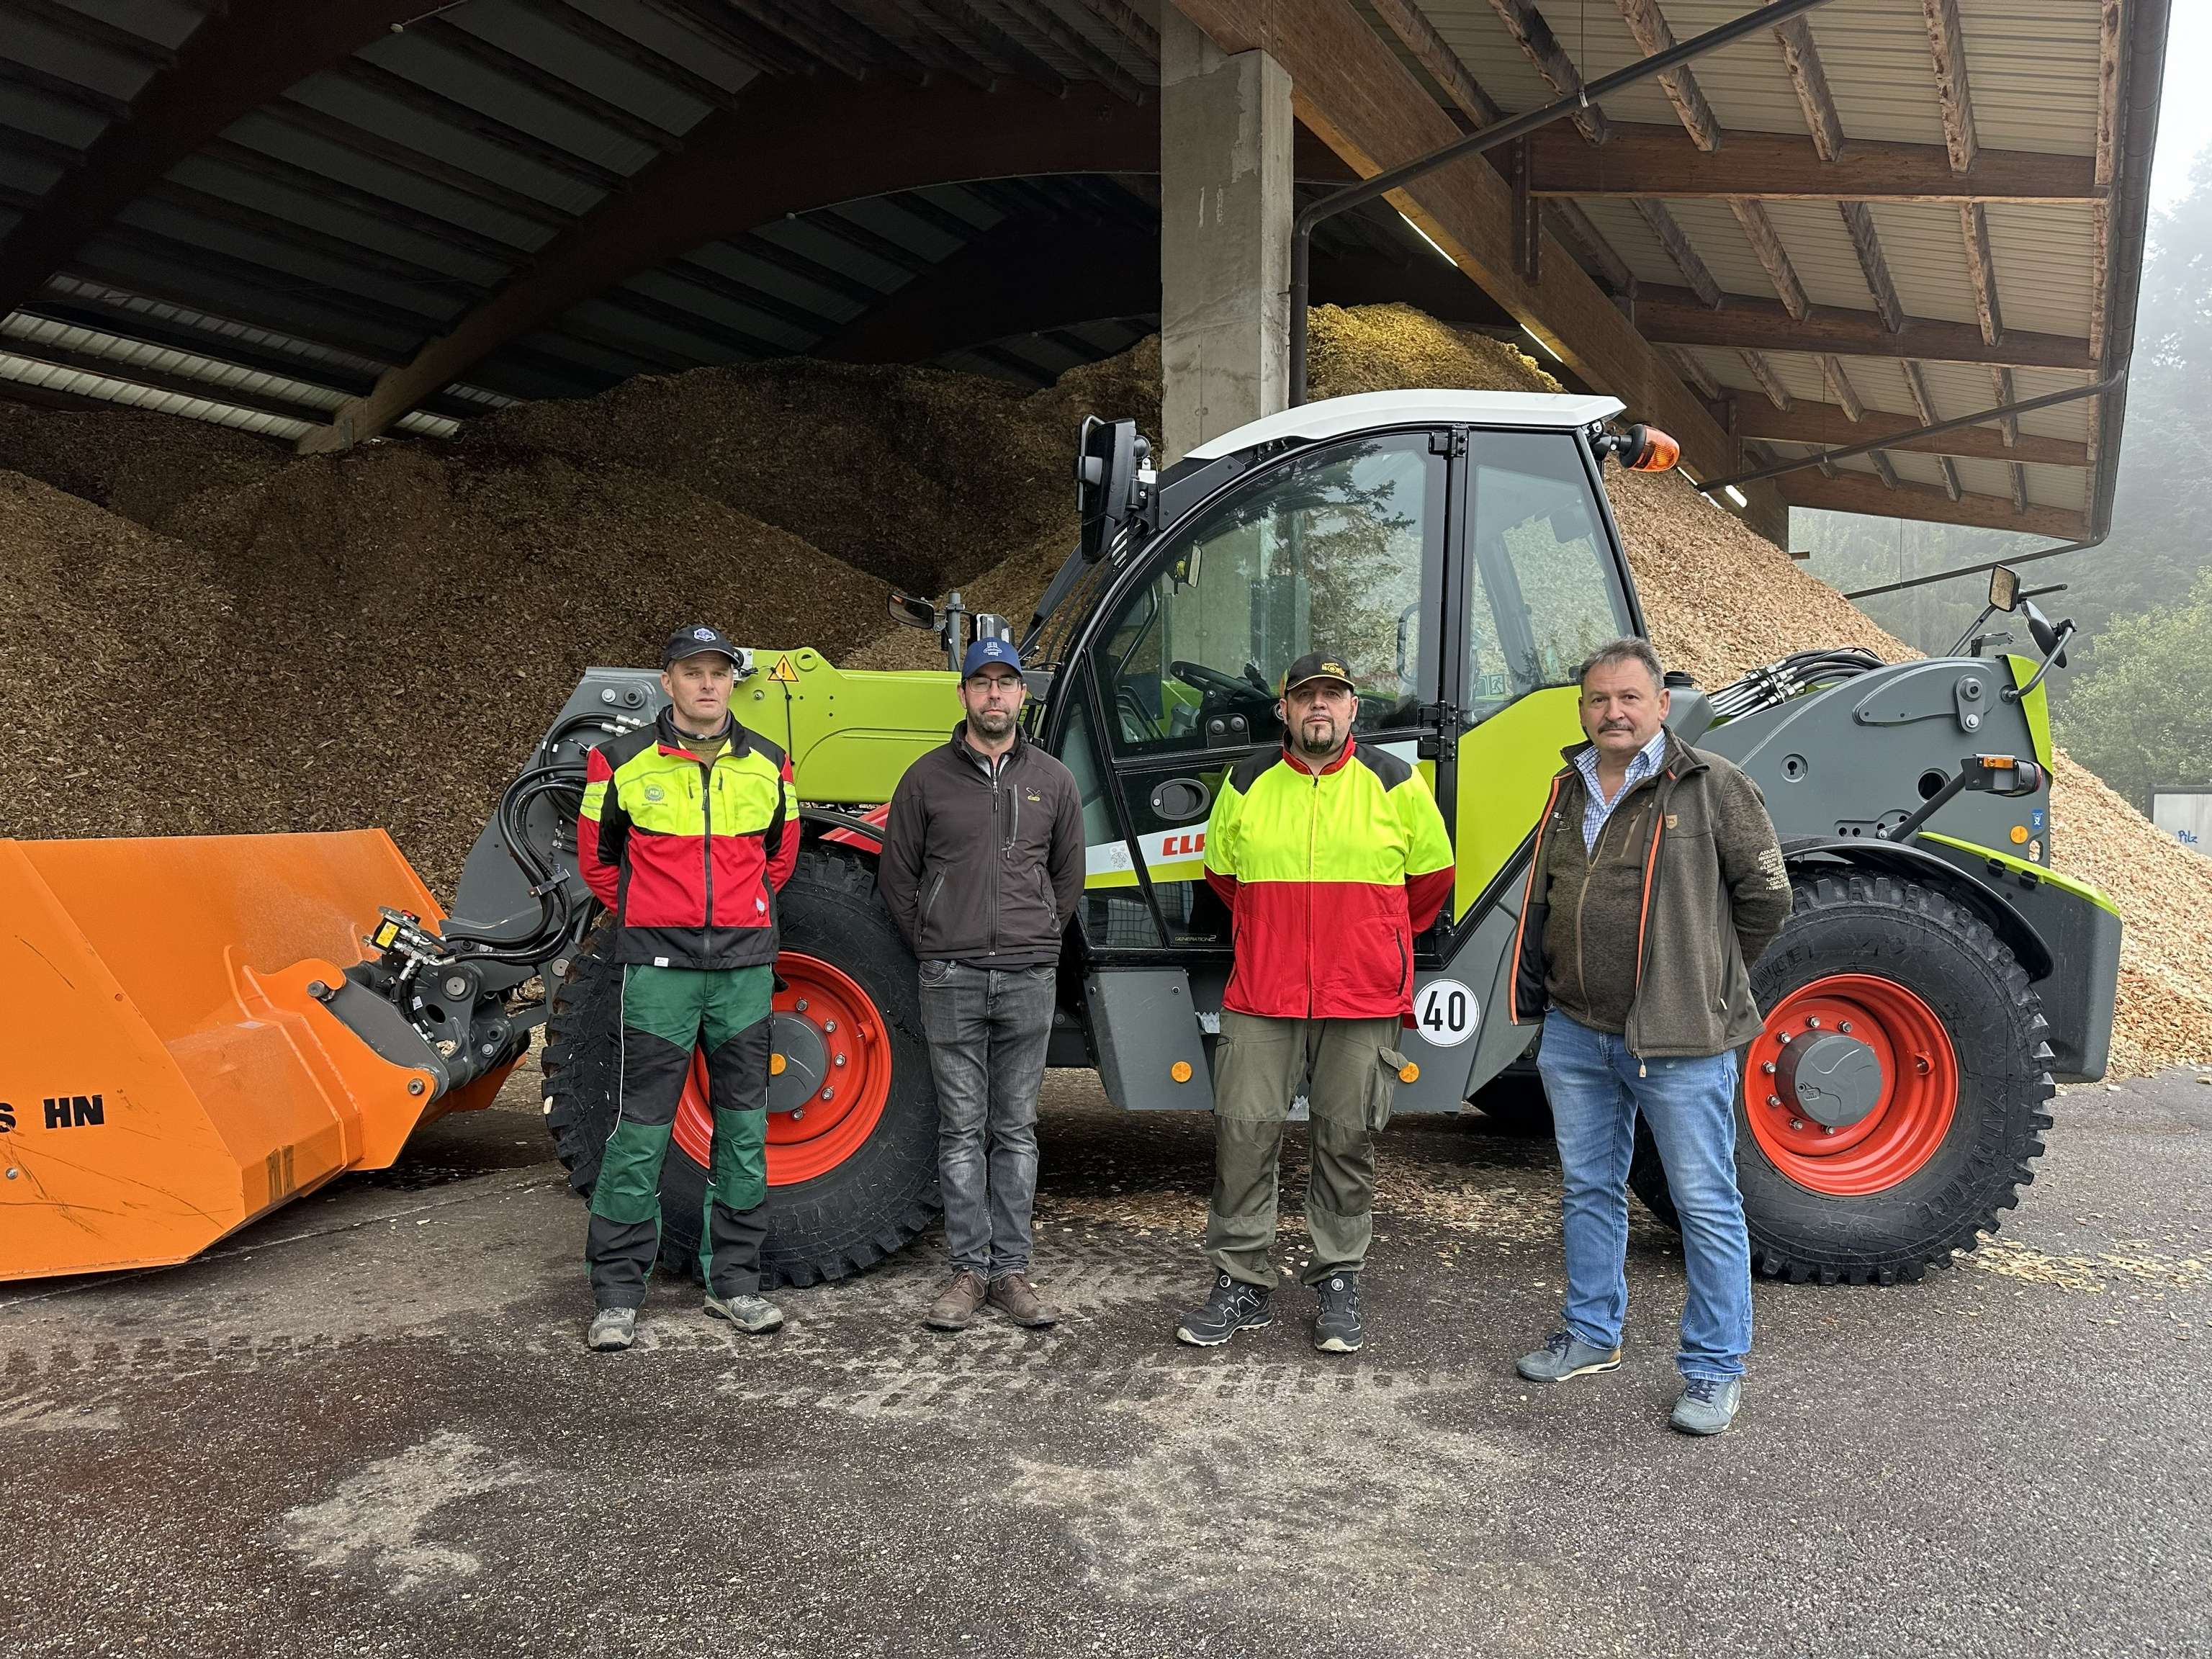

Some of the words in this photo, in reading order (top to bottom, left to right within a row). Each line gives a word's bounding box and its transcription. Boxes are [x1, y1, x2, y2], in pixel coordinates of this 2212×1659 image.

[2178, 830, 2198, 843] Pilz
[1423, 991, 1466, 1032] 40
[43, 1094, 104, 1129] HN
